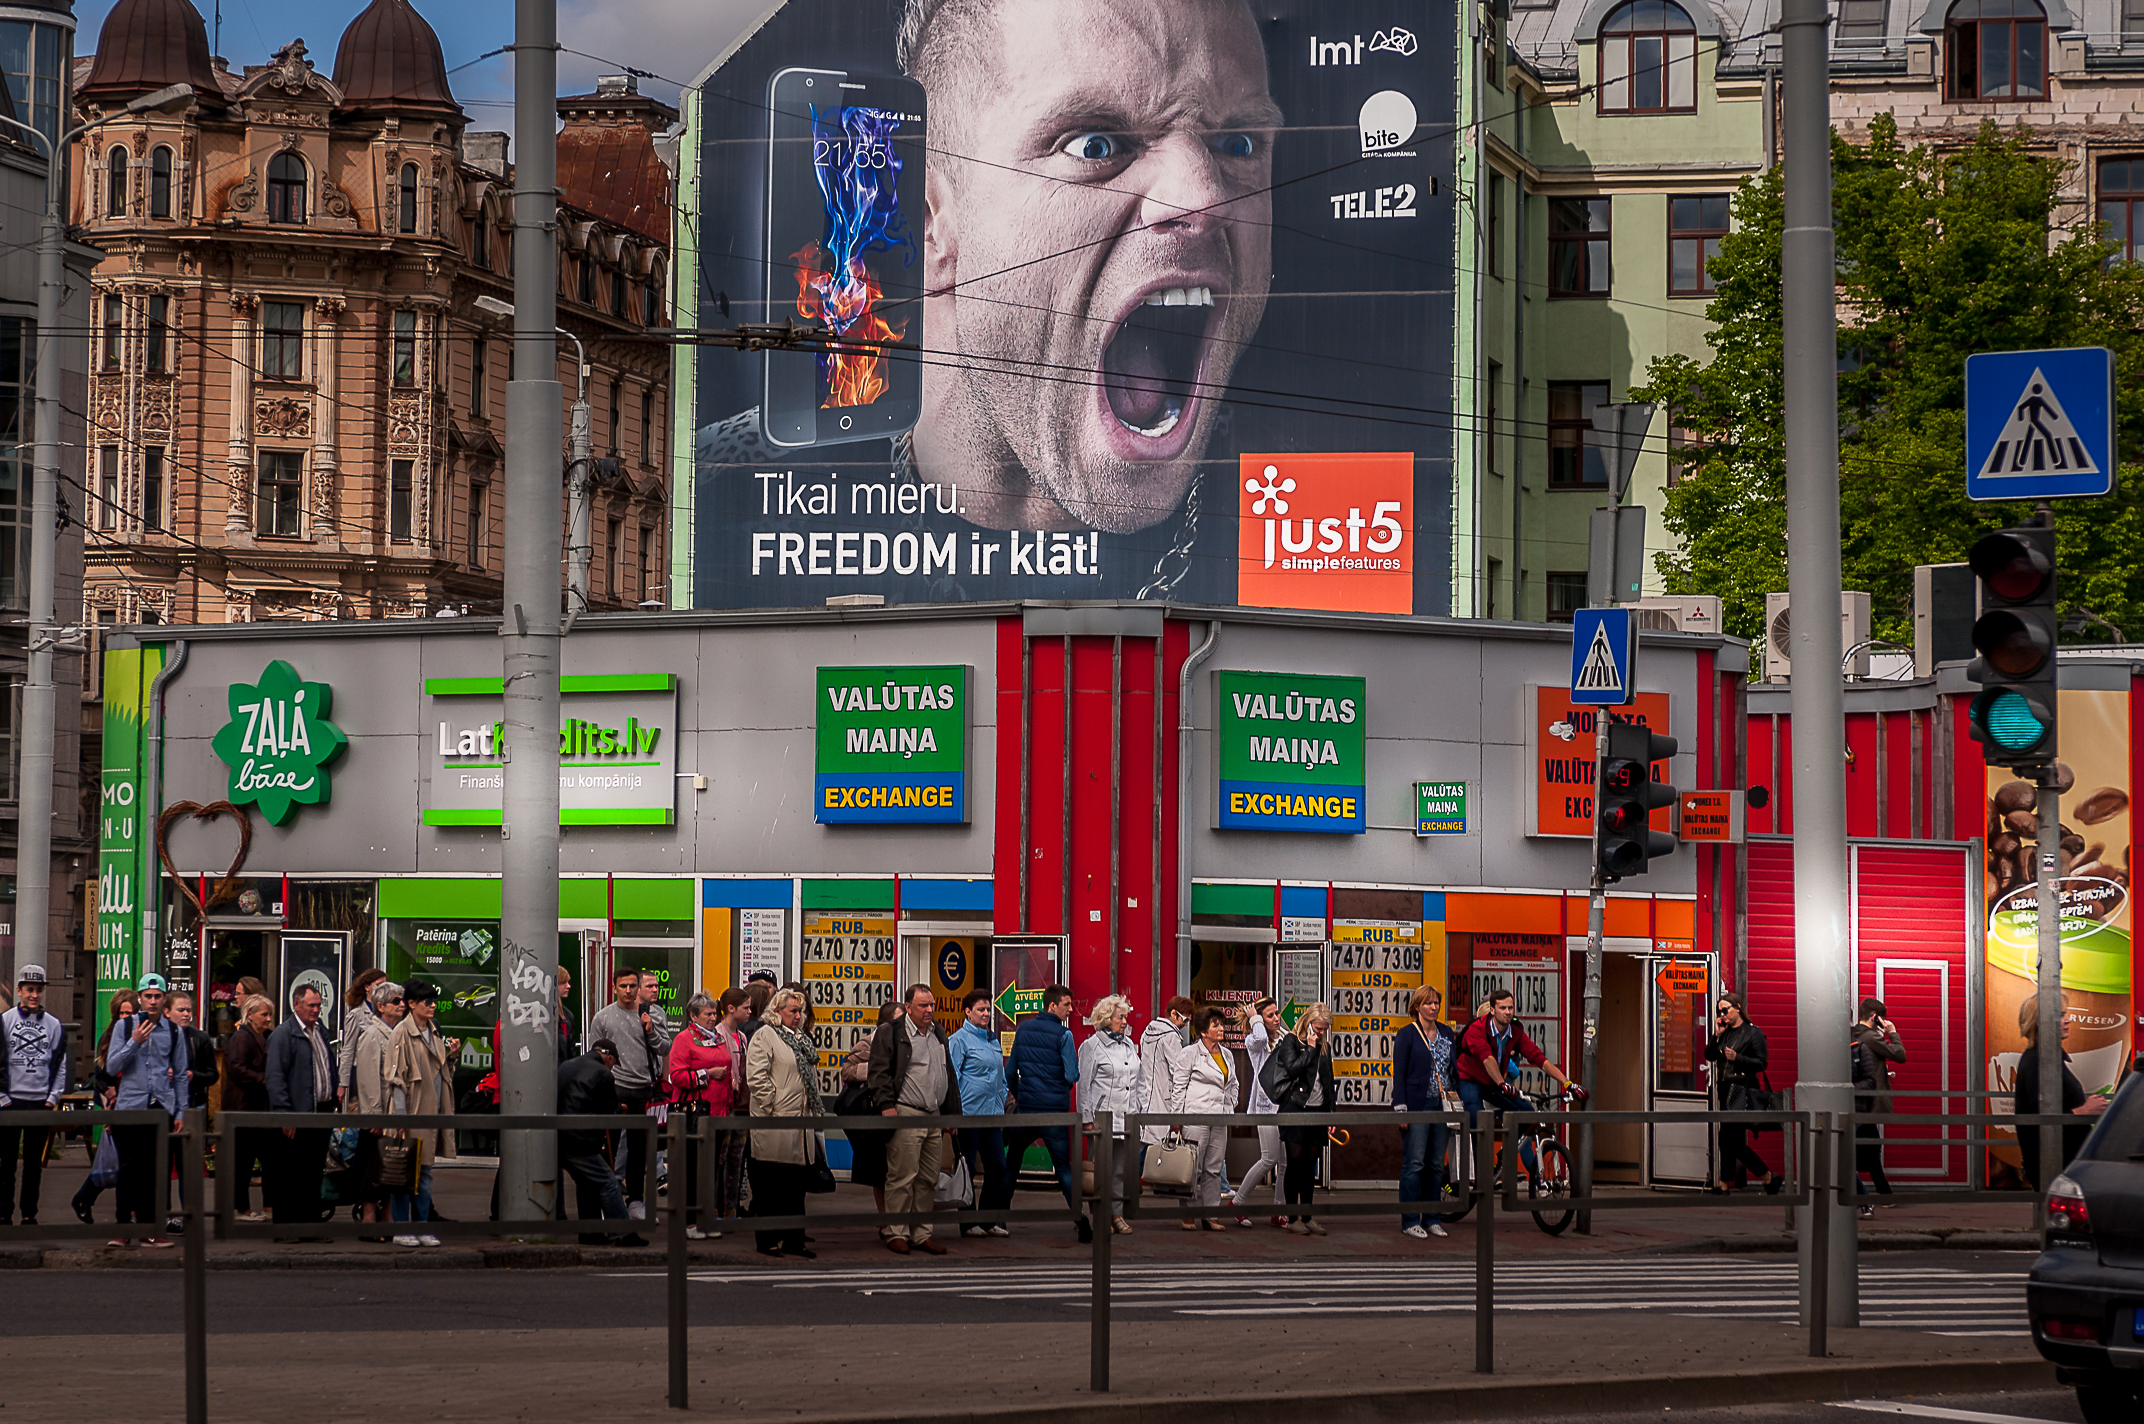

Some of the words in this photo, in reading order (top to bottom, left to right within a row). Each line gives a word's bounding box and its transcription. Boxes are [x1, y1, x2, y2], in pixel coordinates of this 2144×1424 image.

[1310, 35, 1365, 66] lmt
[1365, 129, 1399, 148] bite
[1330, 183, 1417, 219] TELE2
[754, 471, 837, 515] Tikai
[852, 472, 966, 515] mieru.
[1264, 501, 1404, 570] just5
[752, 532, 957, 576] FREEDOM
[971, 532, 1000, 575] ir
[1010, 530, 1098, 575] klāt!
[1281, 555, 1401, 573] simplefeatures
[827, 680, 955, 712] VALŪTAS
[1232, 690, 1357, 724] VALŪTAS
[439, 717, 661, 756] LatKdits.lv
[846, 726, 939, 759] MAIŅA
[1249, 736, 1340, 771] MAIŅA
[235, 758, 314, 791] bāze
[1545, 757, 1597, 785] VALŪTA
[578, 774, 642, 791] kompānija
[1421, 783, 1464, 797] VALŪTAS
[824, 785, 954, 809] EXCHANGE
[1230, 792, 1357, 819] EXCHANGE
[1427, 801, 1458, 816] MAIŅA
[1421, 821, 1463, 831] EXCHANGE
[1691, 827, 1721, 835] EXCHANGE
[2011, 899, 2039, 910] IZBAU
[2073, 886, 2115, 902] ĪSTAJĀM
[2059, 904, 2093, 918] EPTĒM
[832, 921, 864, 934] RUB
[2059, 919, 2088, 932] AFIJU
[416, 928, 457, 945] Patēriņa
[1363, 929, 1393, 942] RUB
[804, 938, 843, 960] 74.70
[850, 938, 894, 961] 73.09
[1334, 945, 1374, 969] 74.70
[1382, 947, 1421, 970] 73.09
[1490, 948, 1538, 957] EXCHANGE
[426, 956, 443, 964] 15000
[832, 965, 864, 979] USD
[1362, 974, 1392, 987] USD
[1673, 982, 1698, 990] EXCHANGE
[1015, 992, 1044, 1001] ATVĒRT
[1206, 990, 1262, 1001] KLIENTU
[1334, 990, 1373, 1013] 1.393
[1381, 991, 1411, 1014] 1.11
[832, 1010, 863, 1023] GBP
[1359, 1018, 1390, 1031] GBP
[2069, 1013, 2115, 1025] RVESEN
[15, 1020, 46, 1033] CHOICE
[813, 1026, 841, 1050] 881
[1333, 1034, 1371, 1058] 0.881
[1360, 1063, 1391, 1076] DKK
